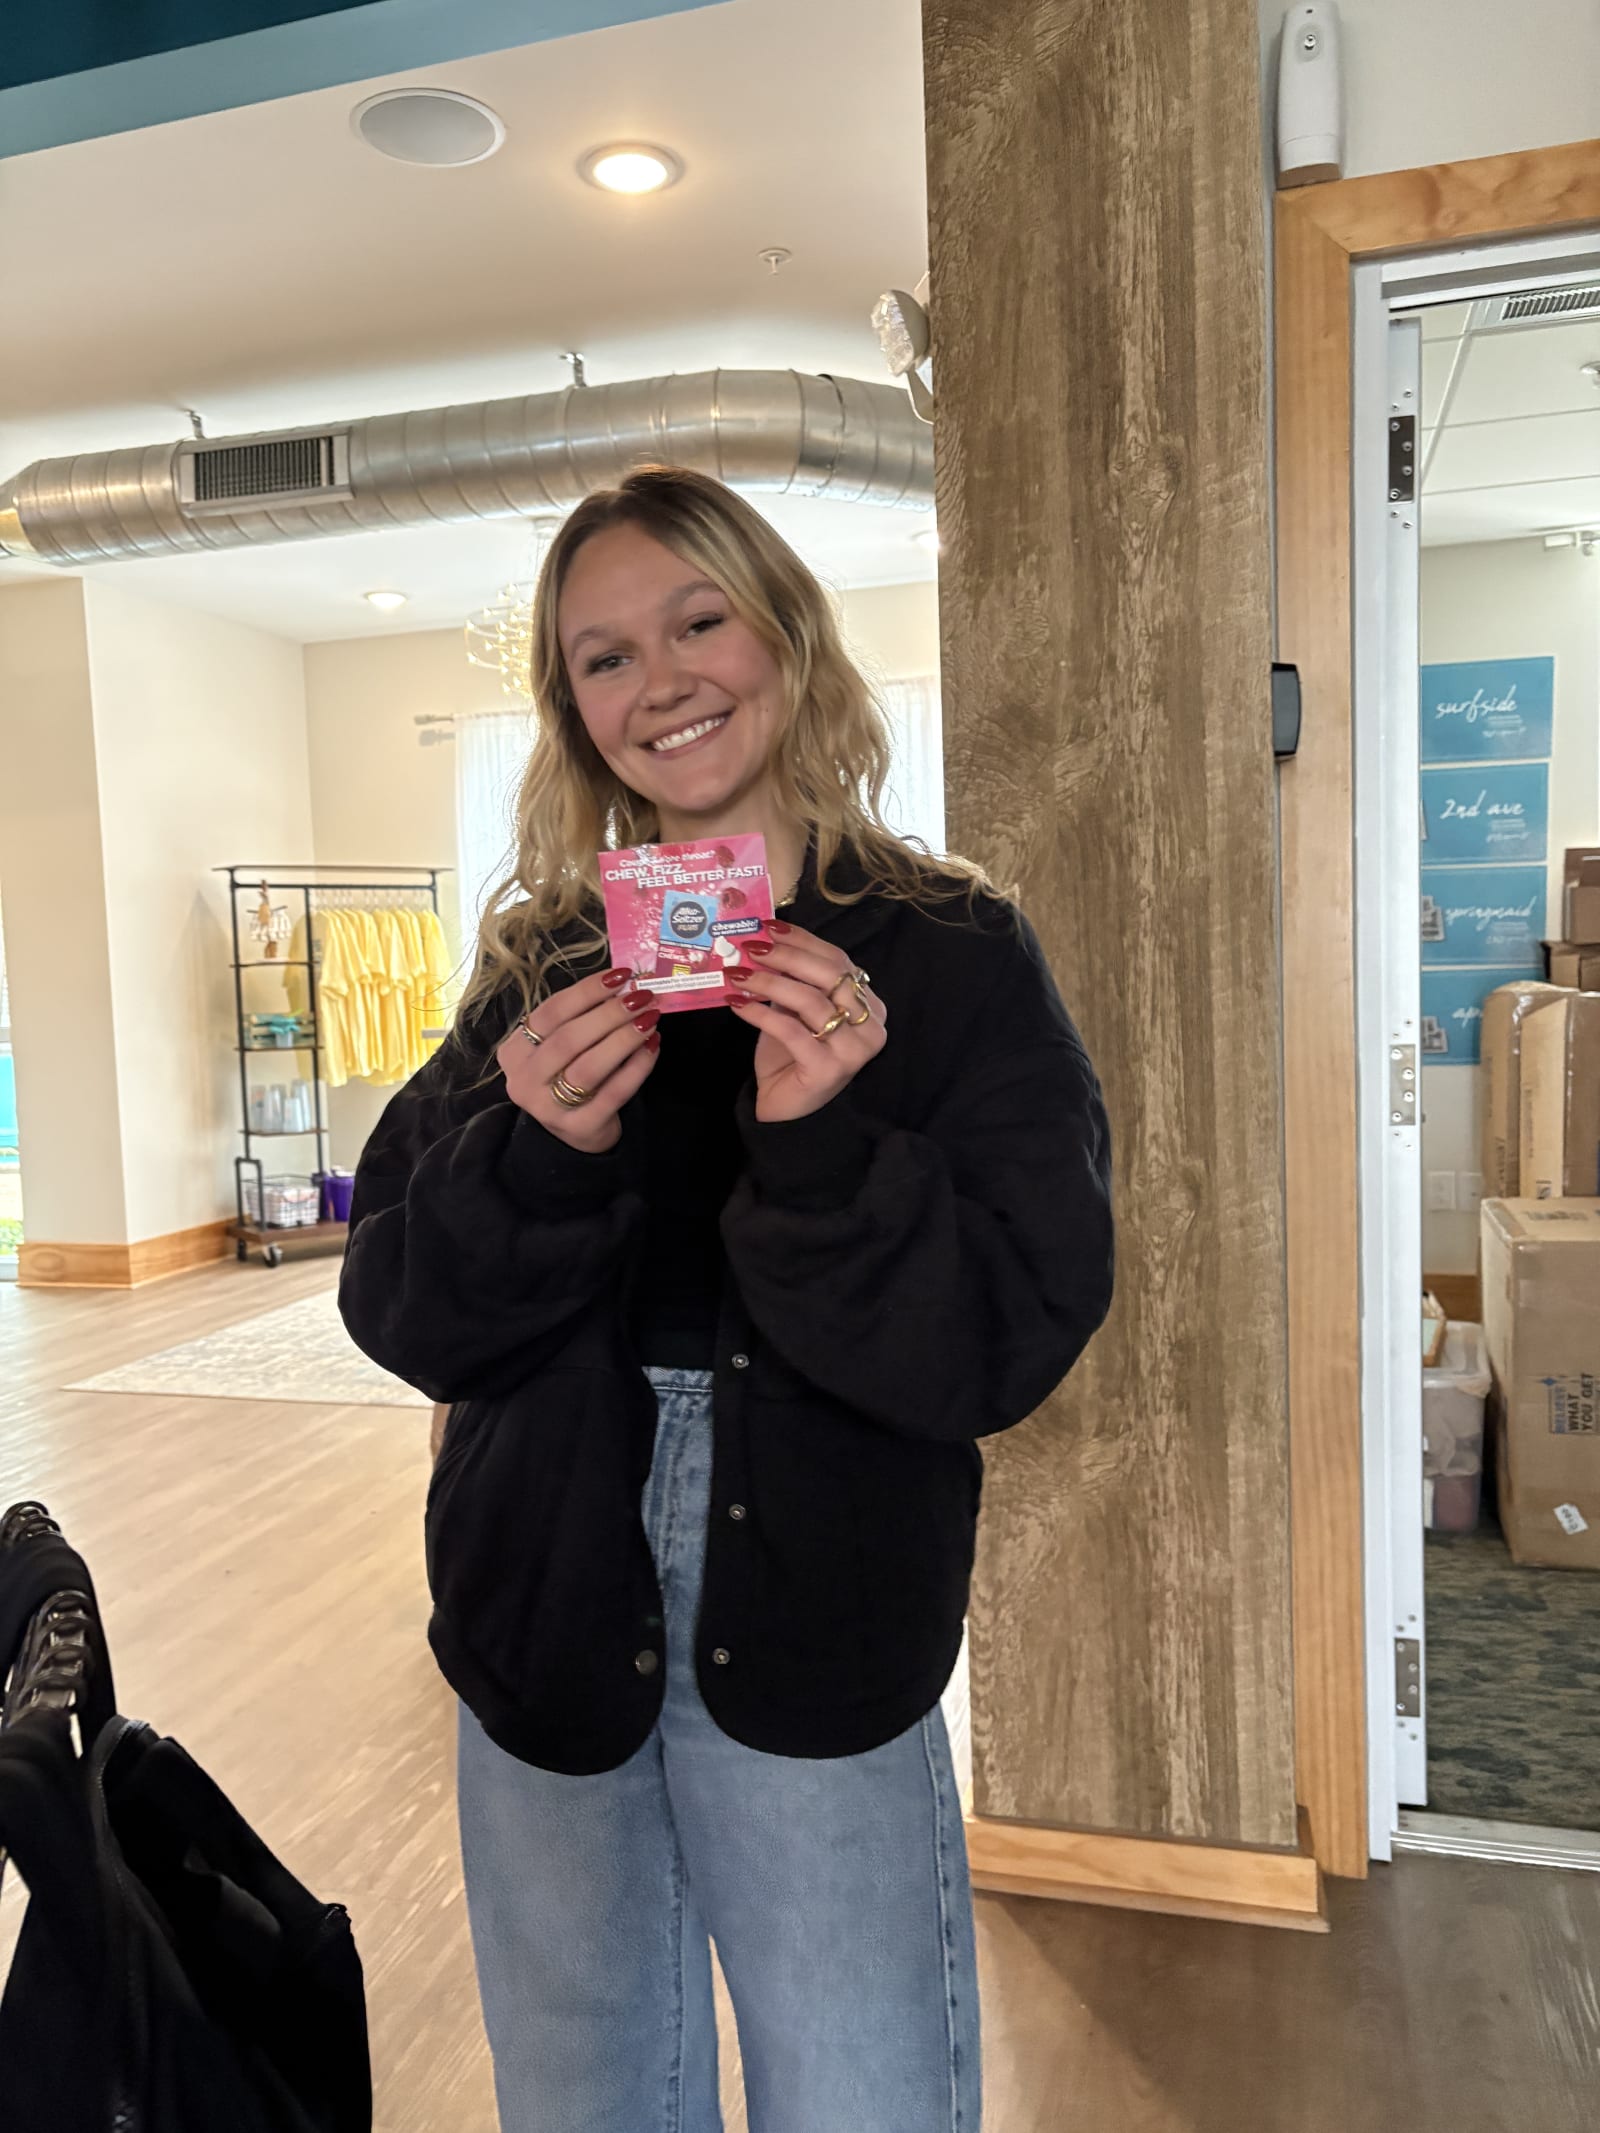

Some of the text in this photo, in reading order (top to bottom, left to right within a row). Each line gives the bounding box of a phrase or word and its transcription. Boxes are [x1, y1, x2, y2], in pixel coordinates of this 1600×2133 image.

[1435, 683, 1518, 723] surfside
[1440, 789, 1525, 819] 2nd ave
[605, 864, 650, 881] CHEW.
[637, 865, 765, 889] FEEL BETTER FAST!
[1567, 1392, 1579, 1431] WHAT
[1581, 1373, 1594, 1431] YOU GET
